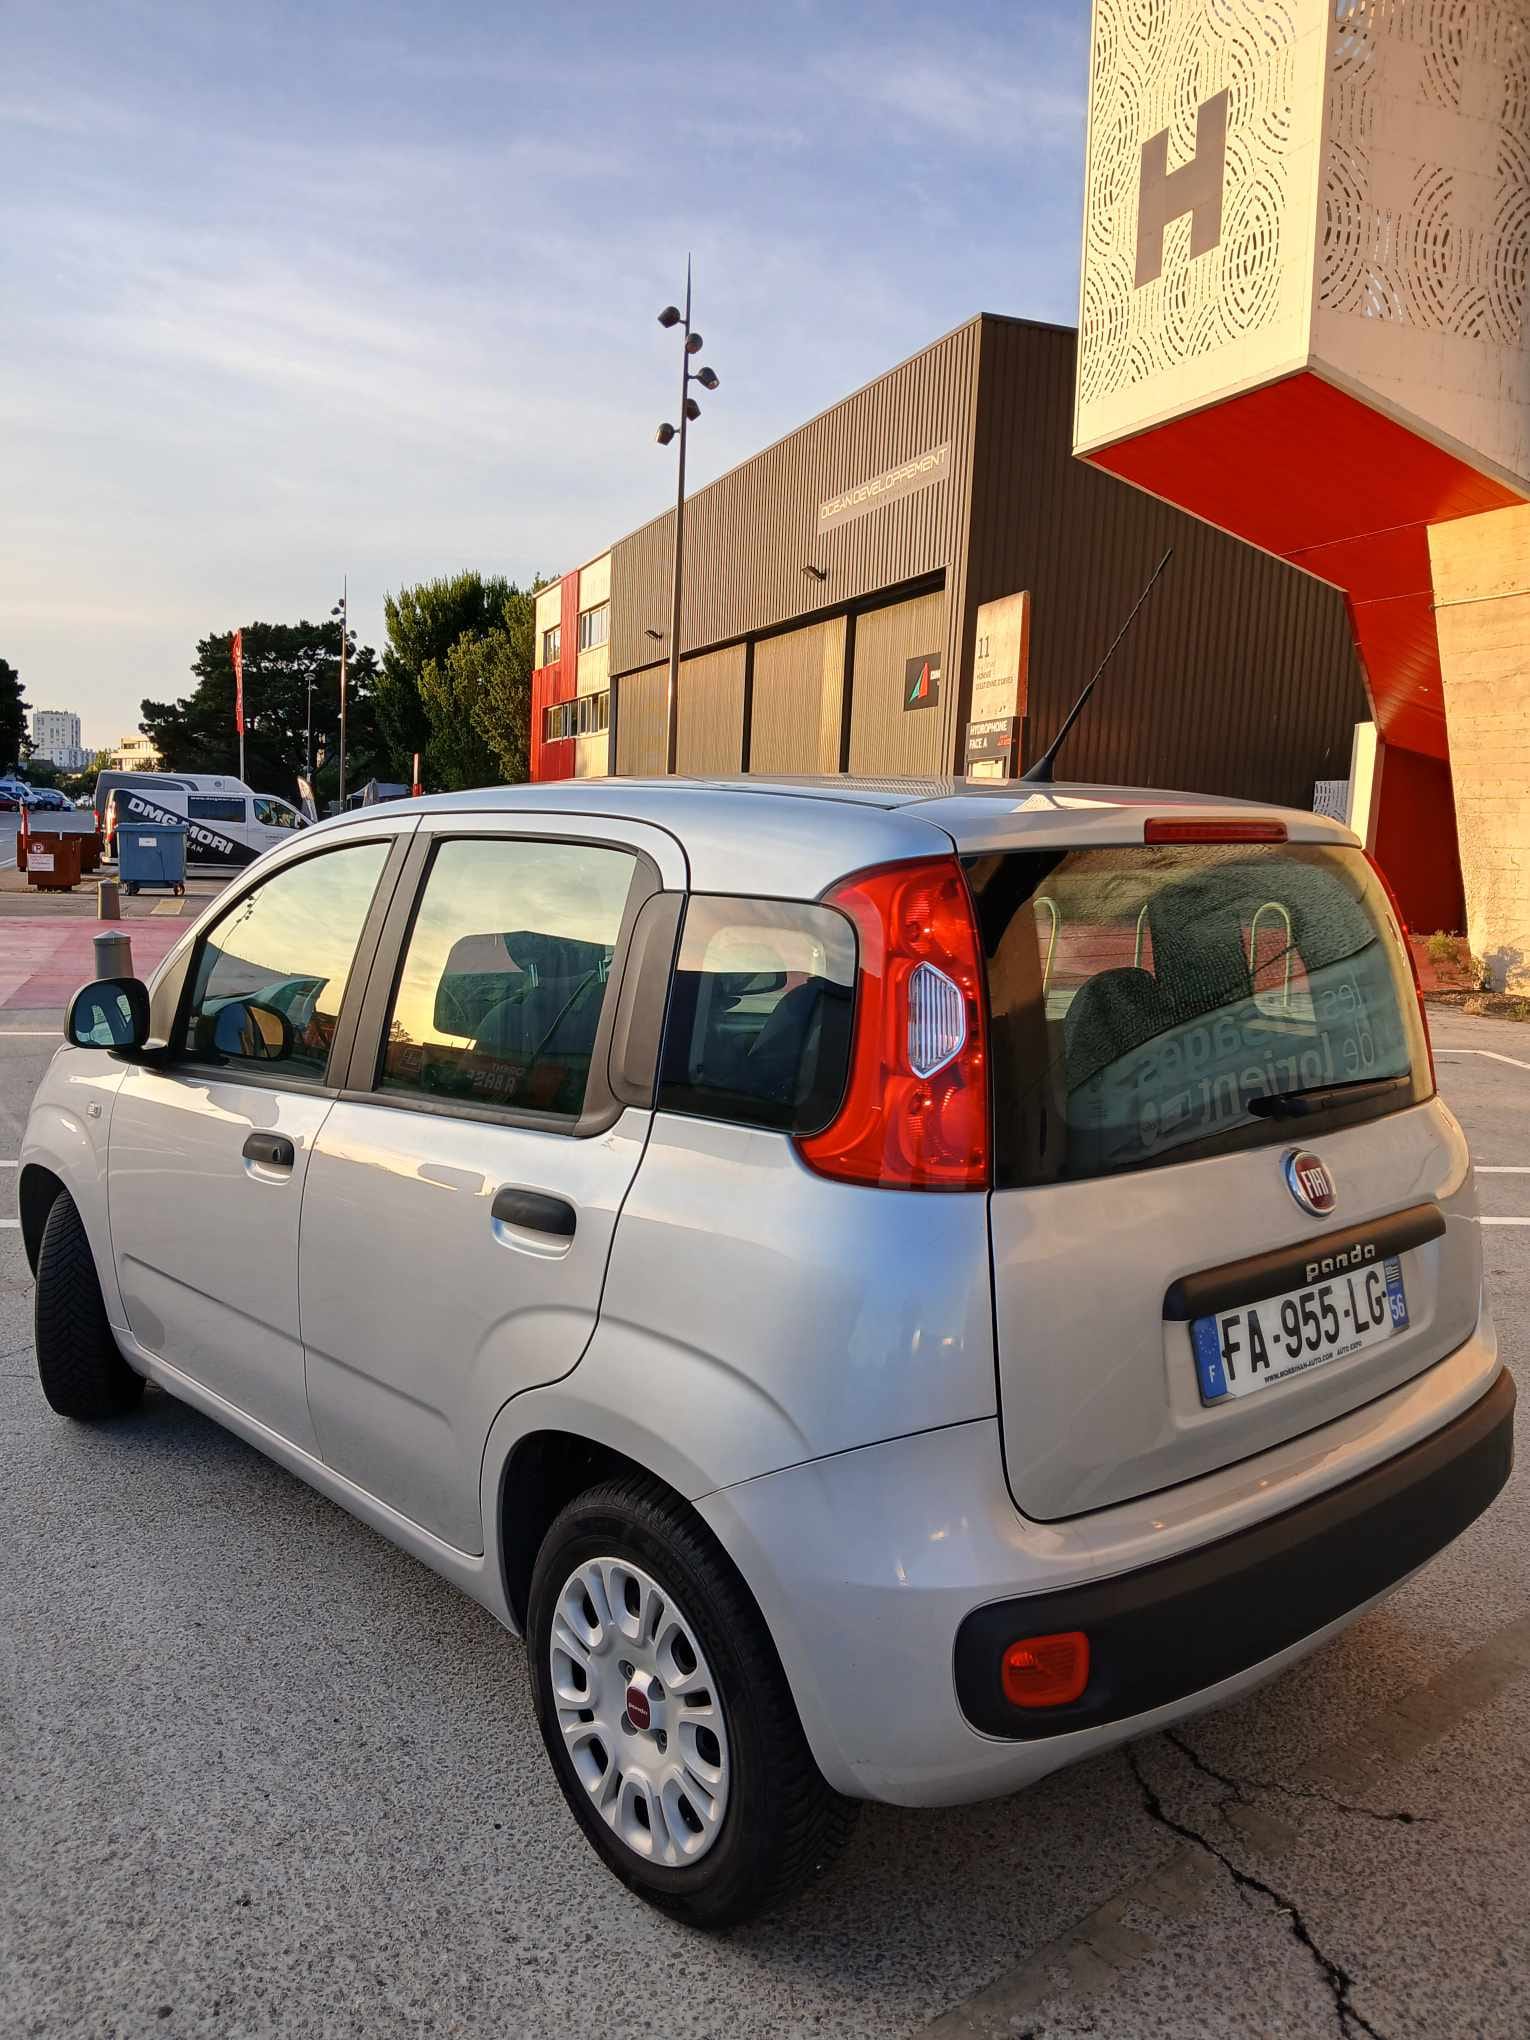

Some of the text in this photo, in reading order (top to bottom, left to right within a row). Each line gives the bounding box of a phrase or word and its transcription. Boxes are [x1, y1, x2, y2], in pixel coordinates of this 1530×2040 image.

[1134, 86, 1229, 290] H
[820, 494, 853, 520] OCEAN
[977, 636, 990, 659] 11
[970, 720, 1008, 735] HYDROPHONE
[968, 738, 983, 750] FACE
[128, 798, 178, 825] DMG
[1300, 1167, 1329, 1199] FIAT
[1305, 1243, 1376, 1282] panda
[1208, 1270, 1405, 1383] F FA-955-LG 56
